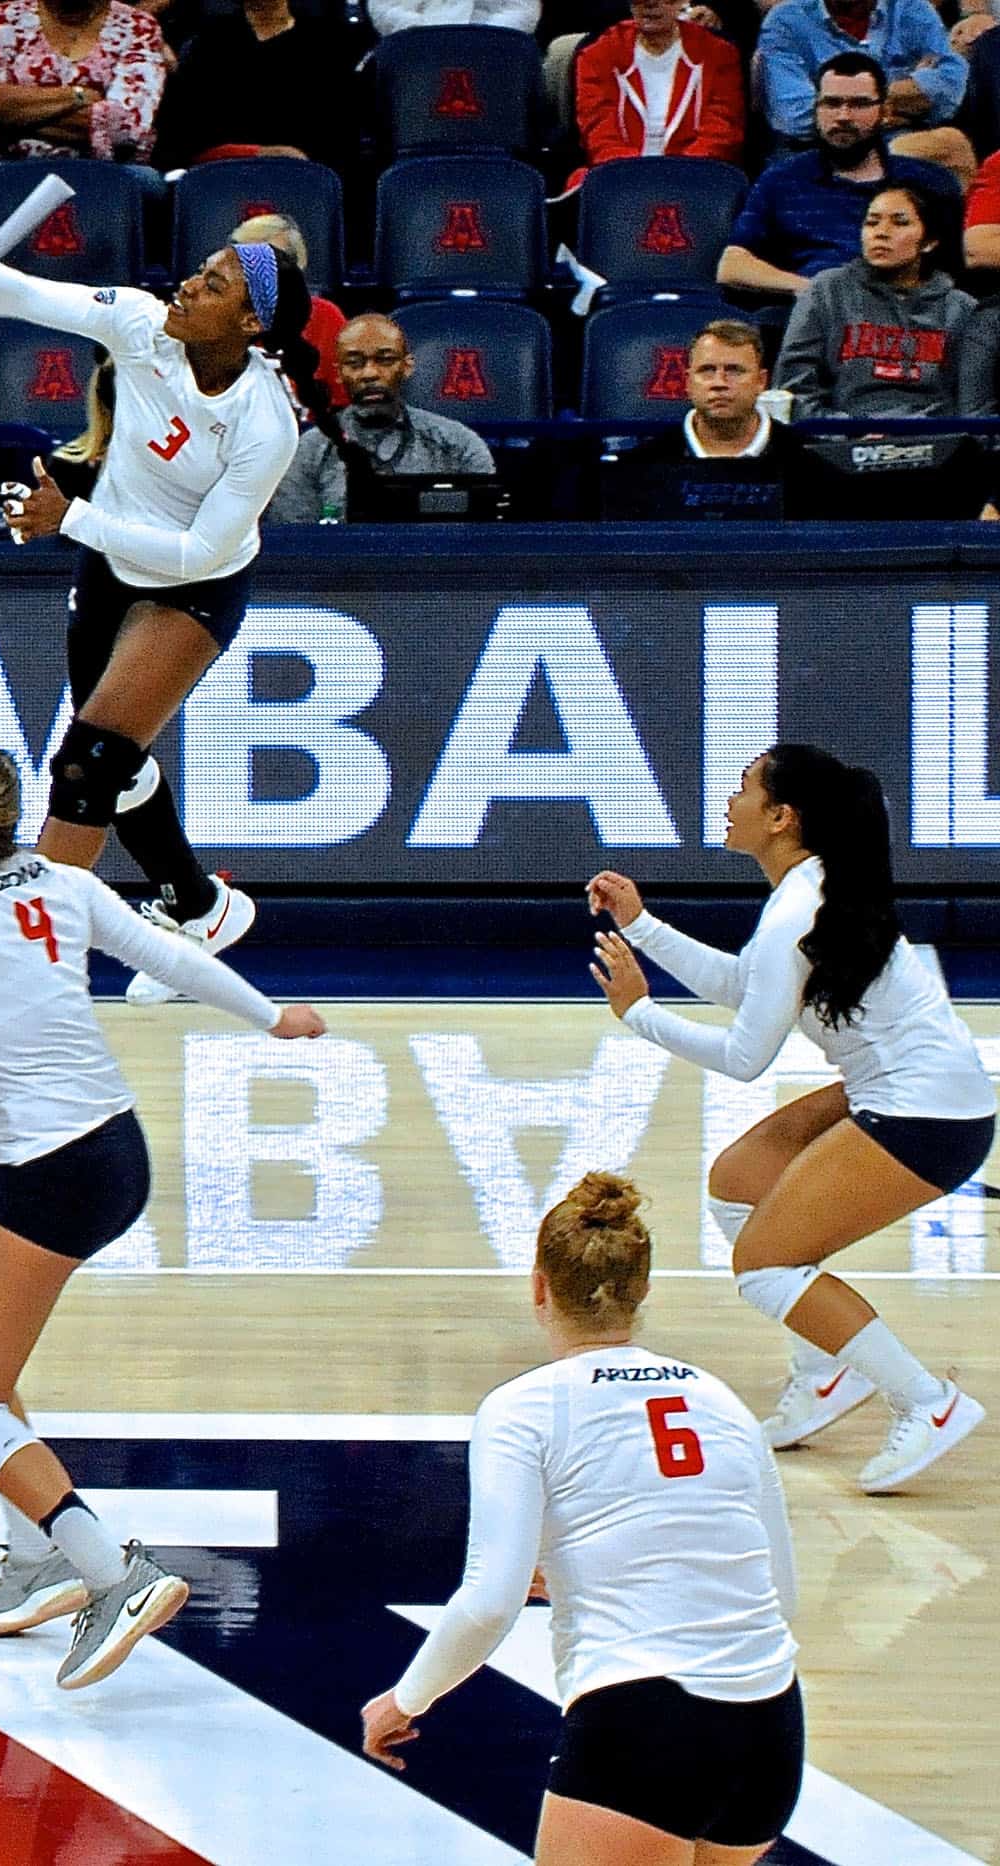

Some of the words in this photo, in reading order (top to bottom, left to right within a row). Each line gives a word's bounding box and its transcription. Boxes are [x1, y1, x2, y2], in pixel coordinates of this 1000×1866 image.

[147, 416, 190, 461] 3
[14, 896, 59, 963] 4
[591, 1366, 699, 1384] ARIZONA
[646, 1396, 704, 1477] 6
